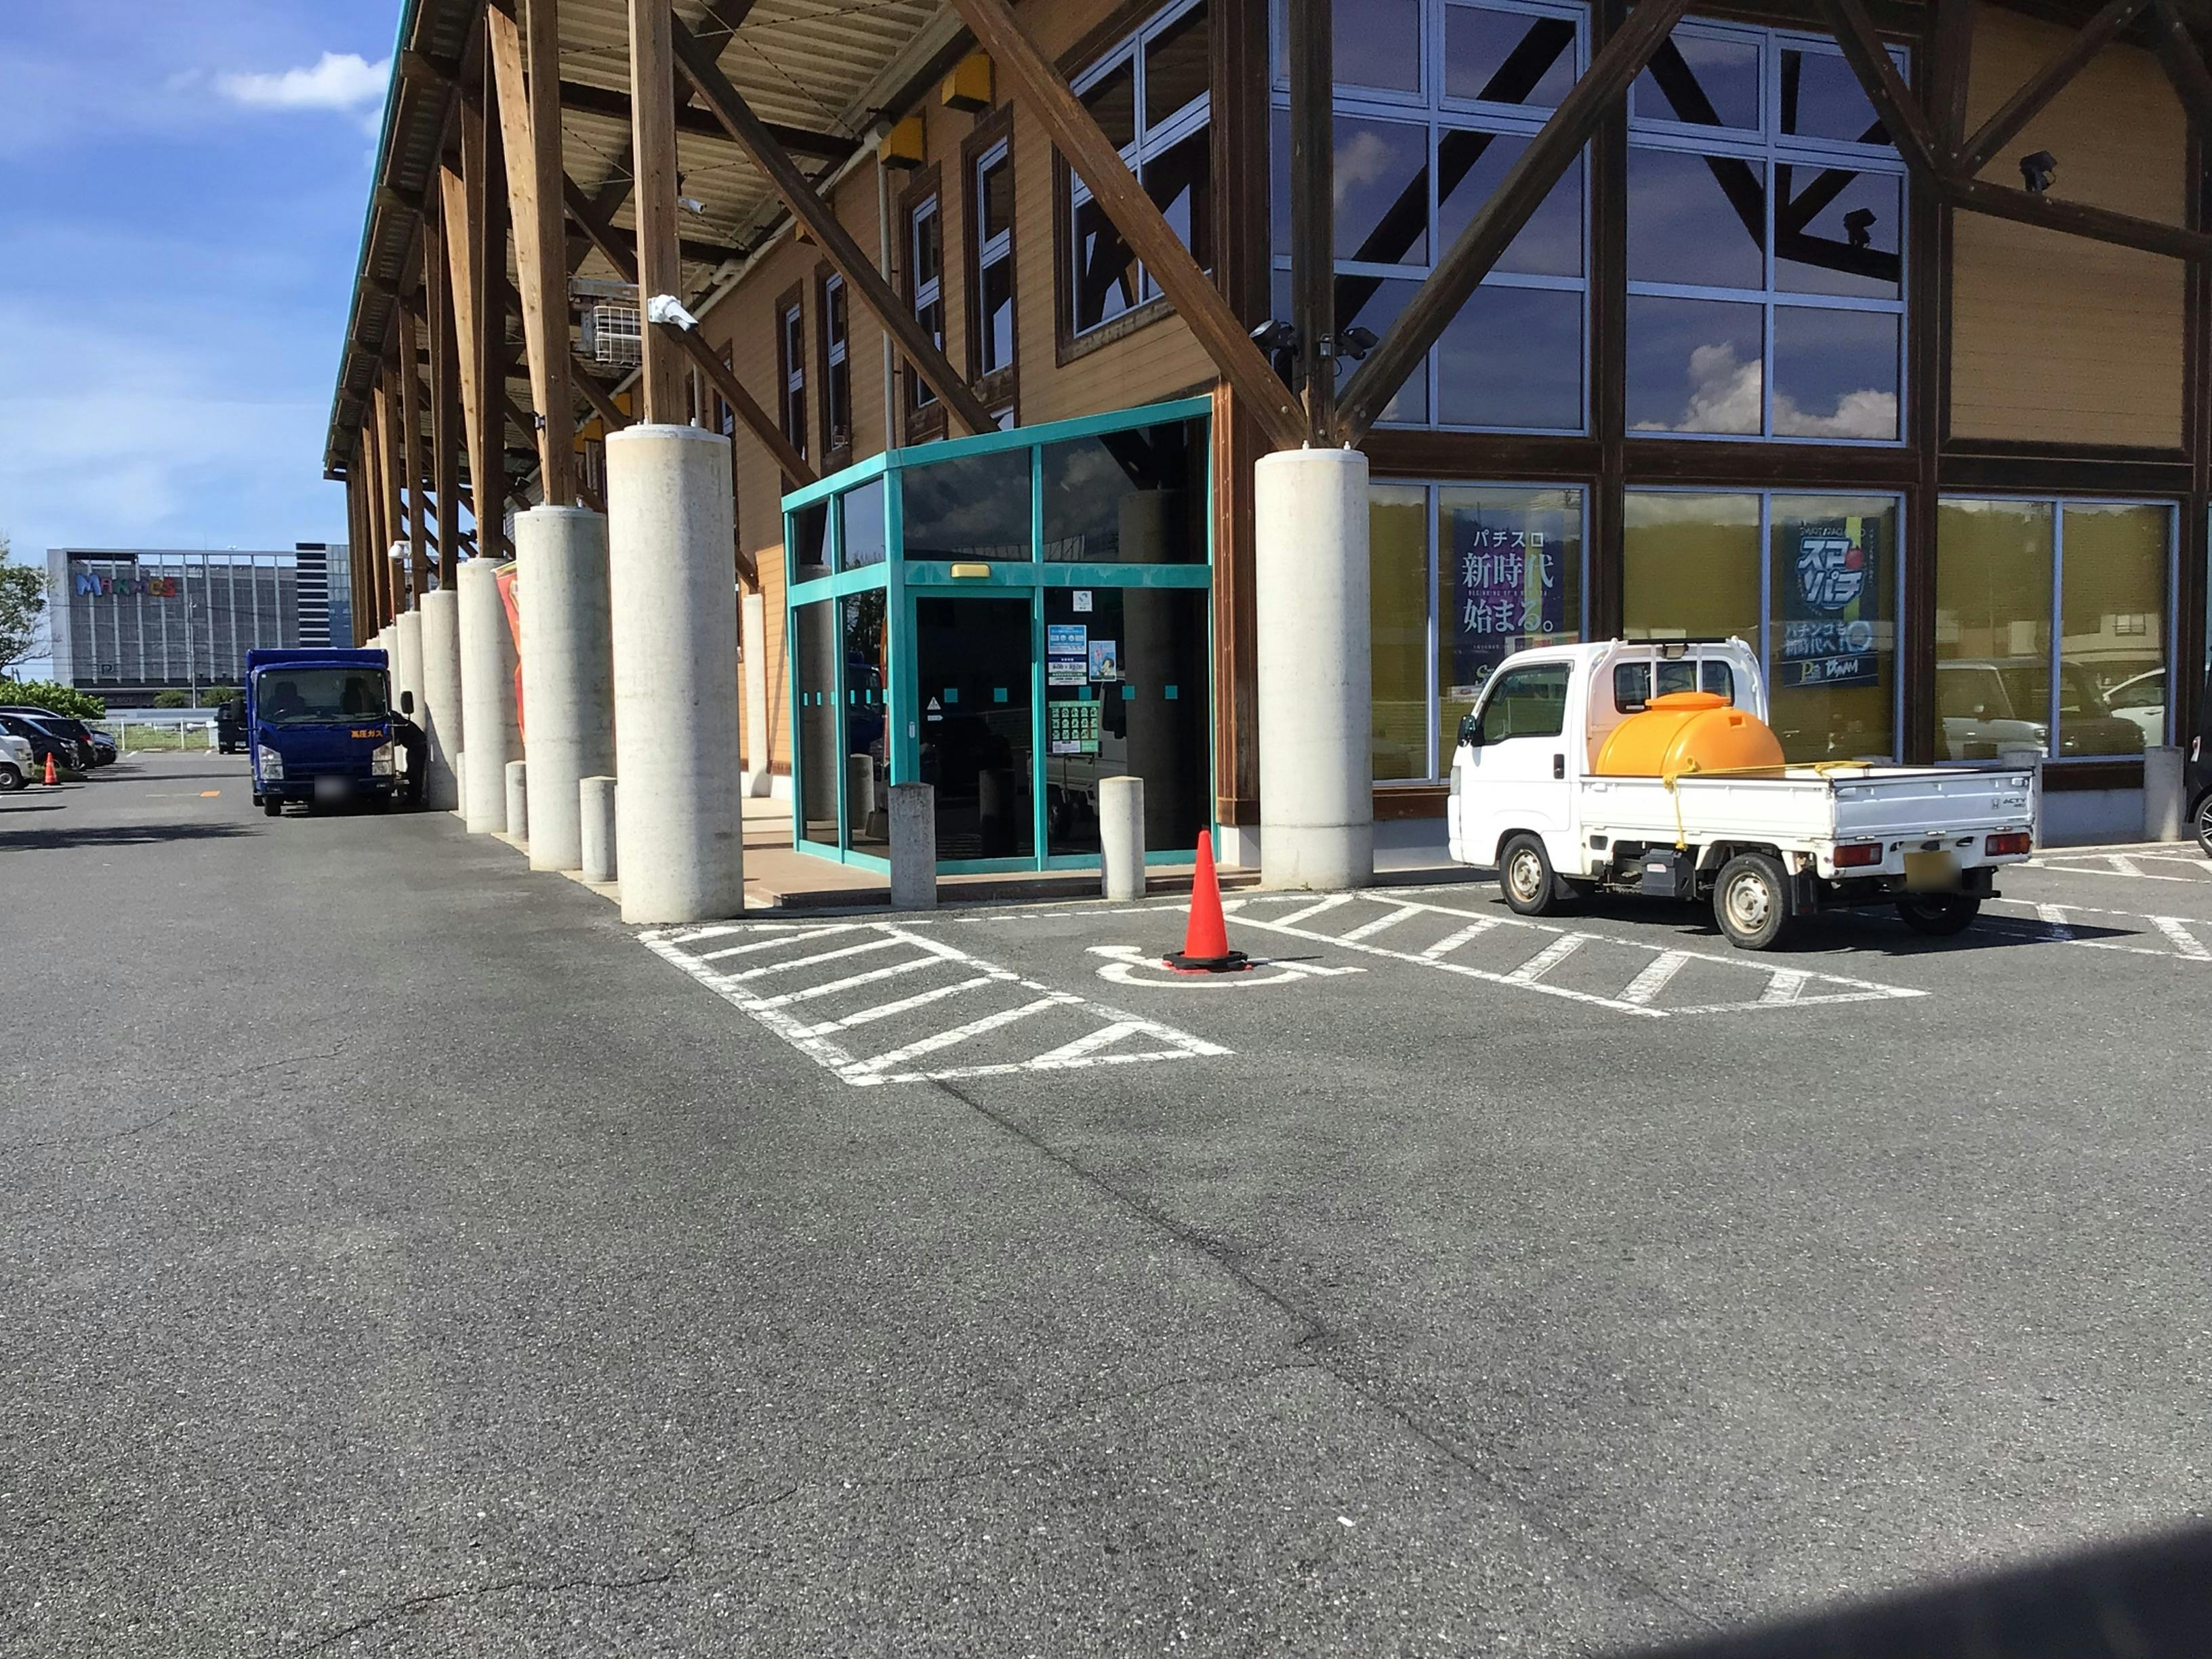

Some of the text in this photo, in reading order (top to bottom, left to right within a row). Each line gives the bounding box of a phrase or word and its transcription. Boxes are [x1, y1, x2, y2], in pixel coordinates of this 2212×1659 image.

[1473, 529, 1544, 548] パチスロ
[1462, 552, 1555, 588] 新時代
[1464, 598, 1553, 634] 始まる。
[351, 730, 384, 738] 高圧ガス
